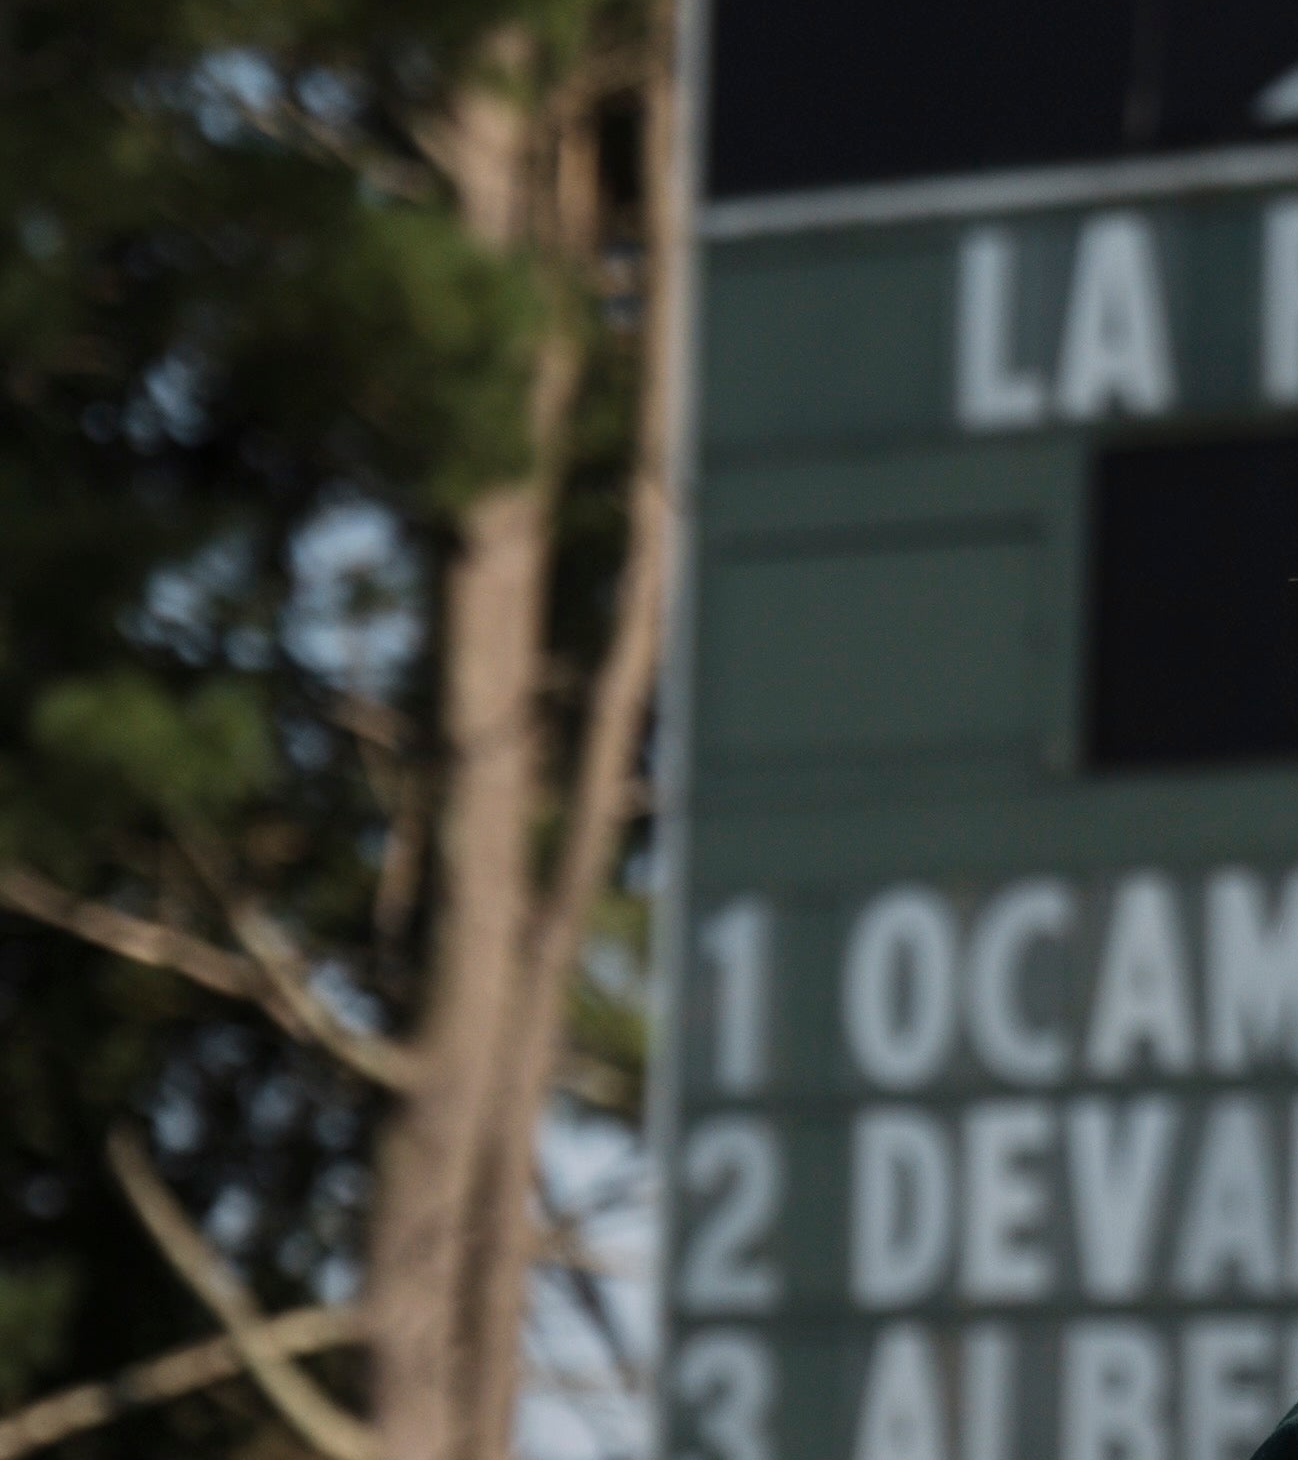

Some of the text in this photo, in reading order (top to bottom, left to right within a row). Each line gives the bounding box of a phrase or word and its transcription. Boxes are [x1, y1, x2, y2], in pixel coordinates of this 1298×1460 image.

[956, 211, 1175, 430] LA
[702, 892, 774, 1094] 1
[678, 1114, 780, 1315] 2
